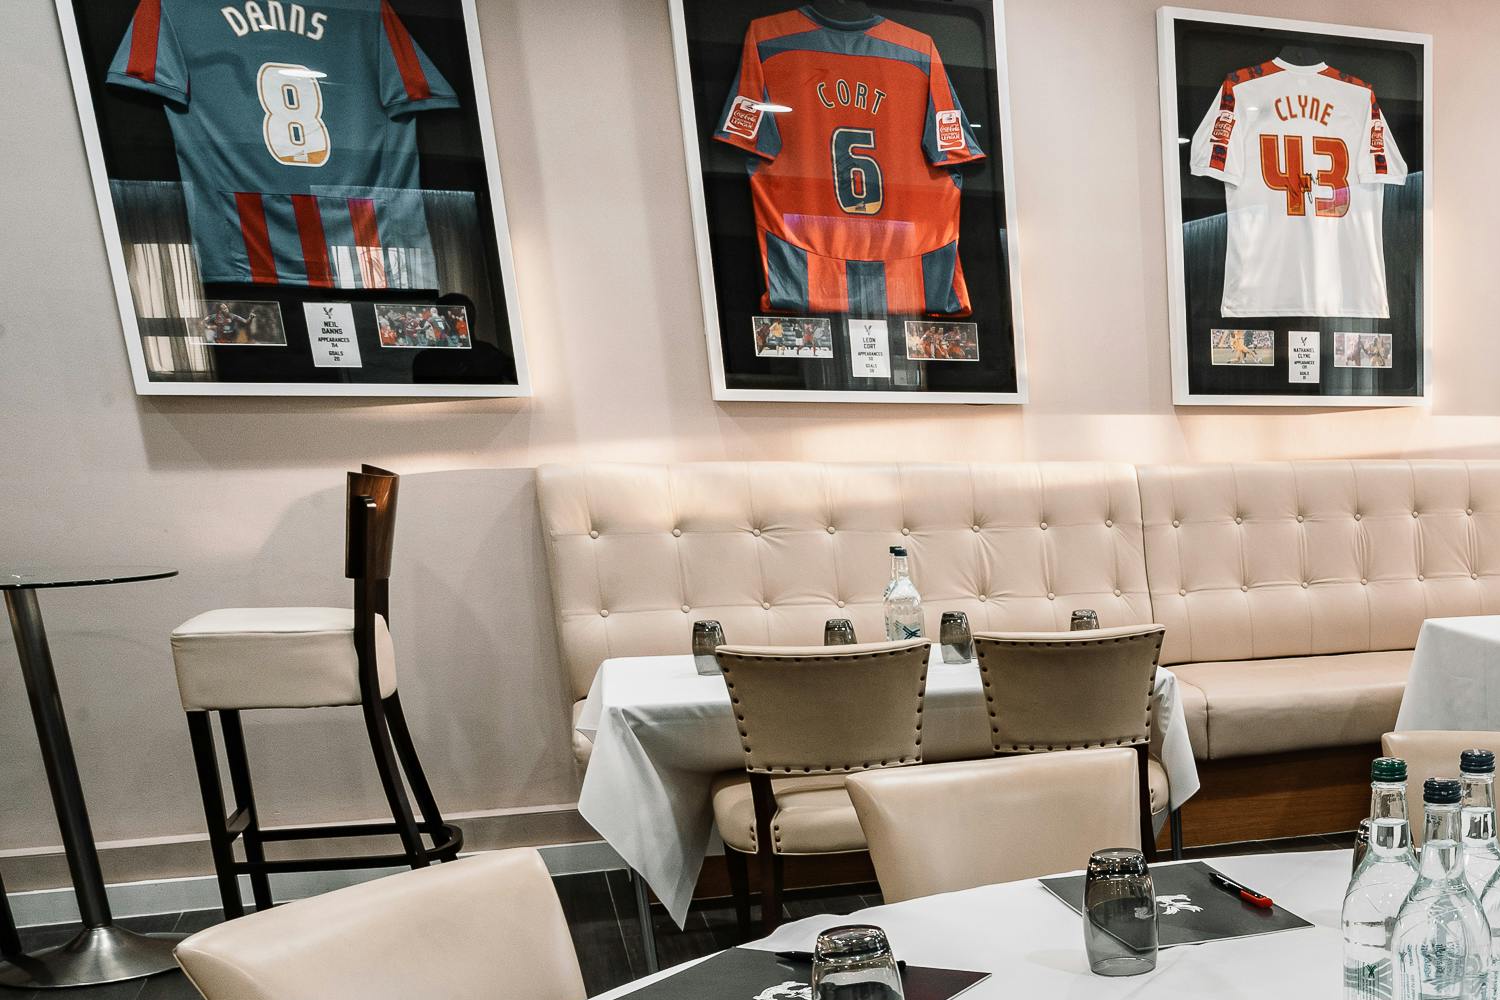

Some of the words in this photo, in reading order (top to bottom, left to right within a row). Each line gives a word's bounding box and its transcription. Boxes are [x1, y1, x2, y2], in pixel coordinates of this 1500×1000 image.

[221, 0, 328, 41] DANNS
[257, 62, 331, 167] 8
[816, 79, 886, 115] CORT
[1274, 94, 1334, 126] CLYNE
[831, 126, 884, 216] 6
[1259, 134, 1350, 218] 43
